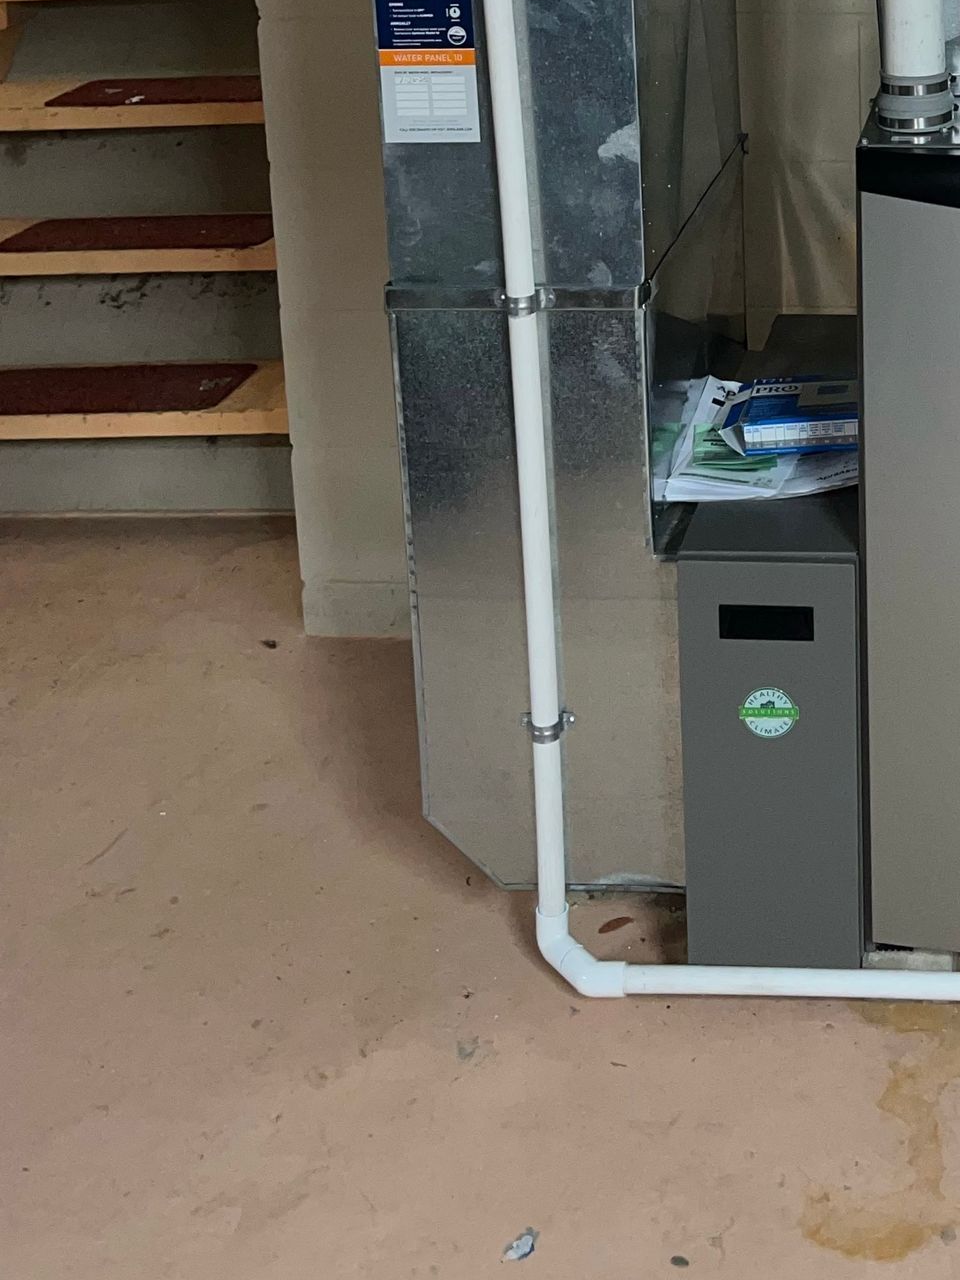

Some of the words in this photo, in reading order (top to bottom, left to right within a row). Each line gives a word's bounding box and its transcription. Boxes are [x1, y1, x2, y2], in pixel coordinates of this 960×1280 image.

[393, 54, 423, 62] WATER
[424, 54, 452, 62] PANEL
[747, 691, 789, 706] HEALTHY
[748, 719, 790, 734] CLIMATE
